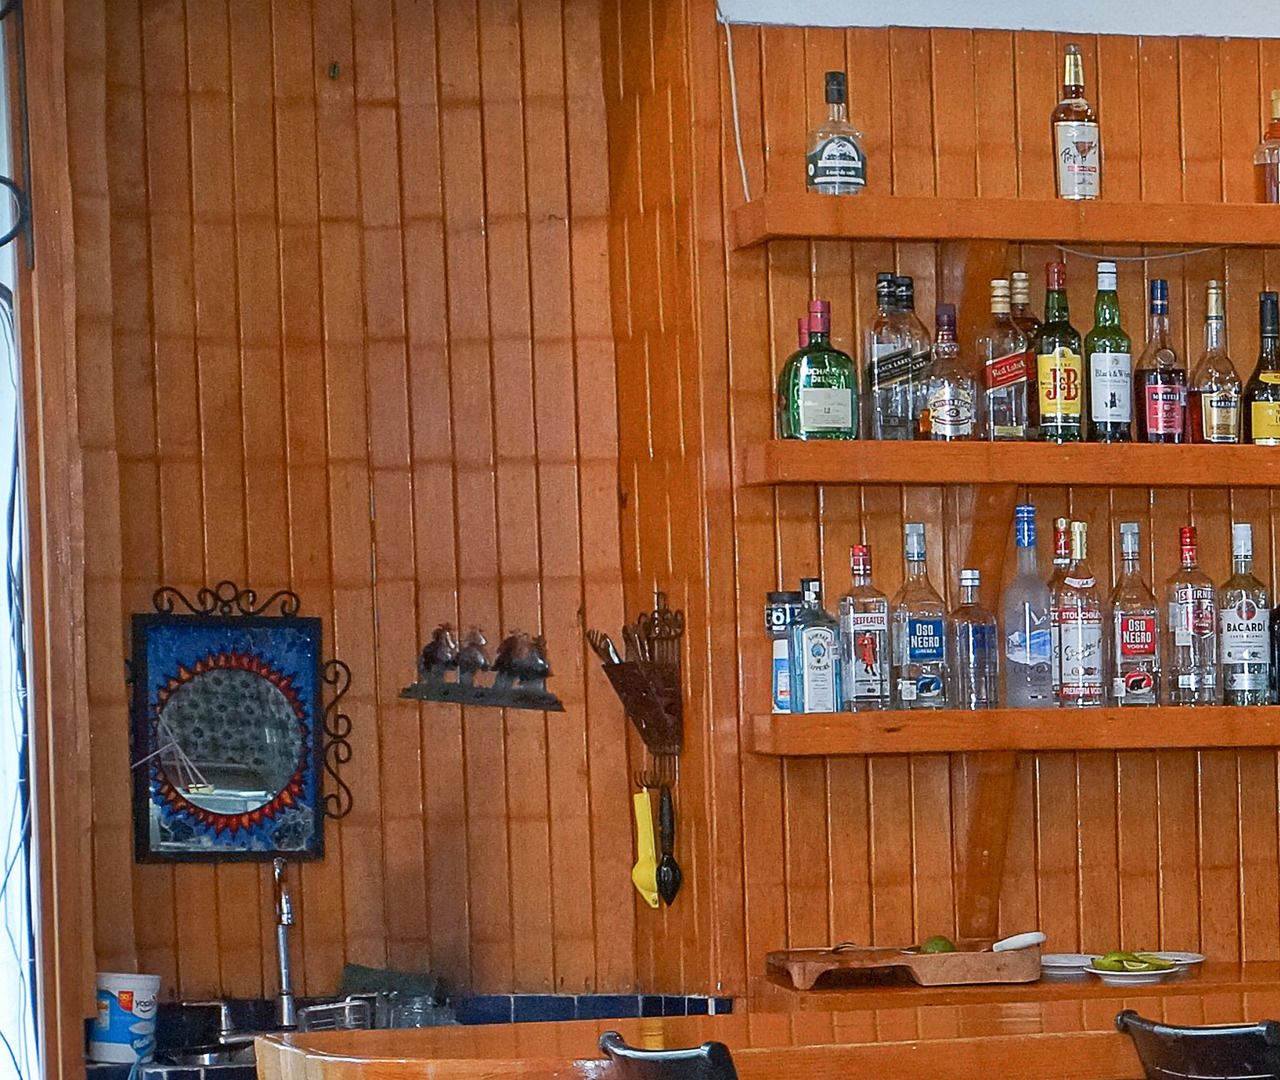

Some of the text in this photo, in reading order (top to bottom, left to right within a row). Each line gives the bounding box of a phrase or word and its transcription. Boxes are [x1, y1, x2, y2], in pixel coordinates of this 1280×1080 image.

[916, 623, 934, 636] OSO
[1128, 619, 1147, 632] OSO
[911, 635, 940, 648] NEGRO
[1123, 631, 1152, 643] NEGRO
